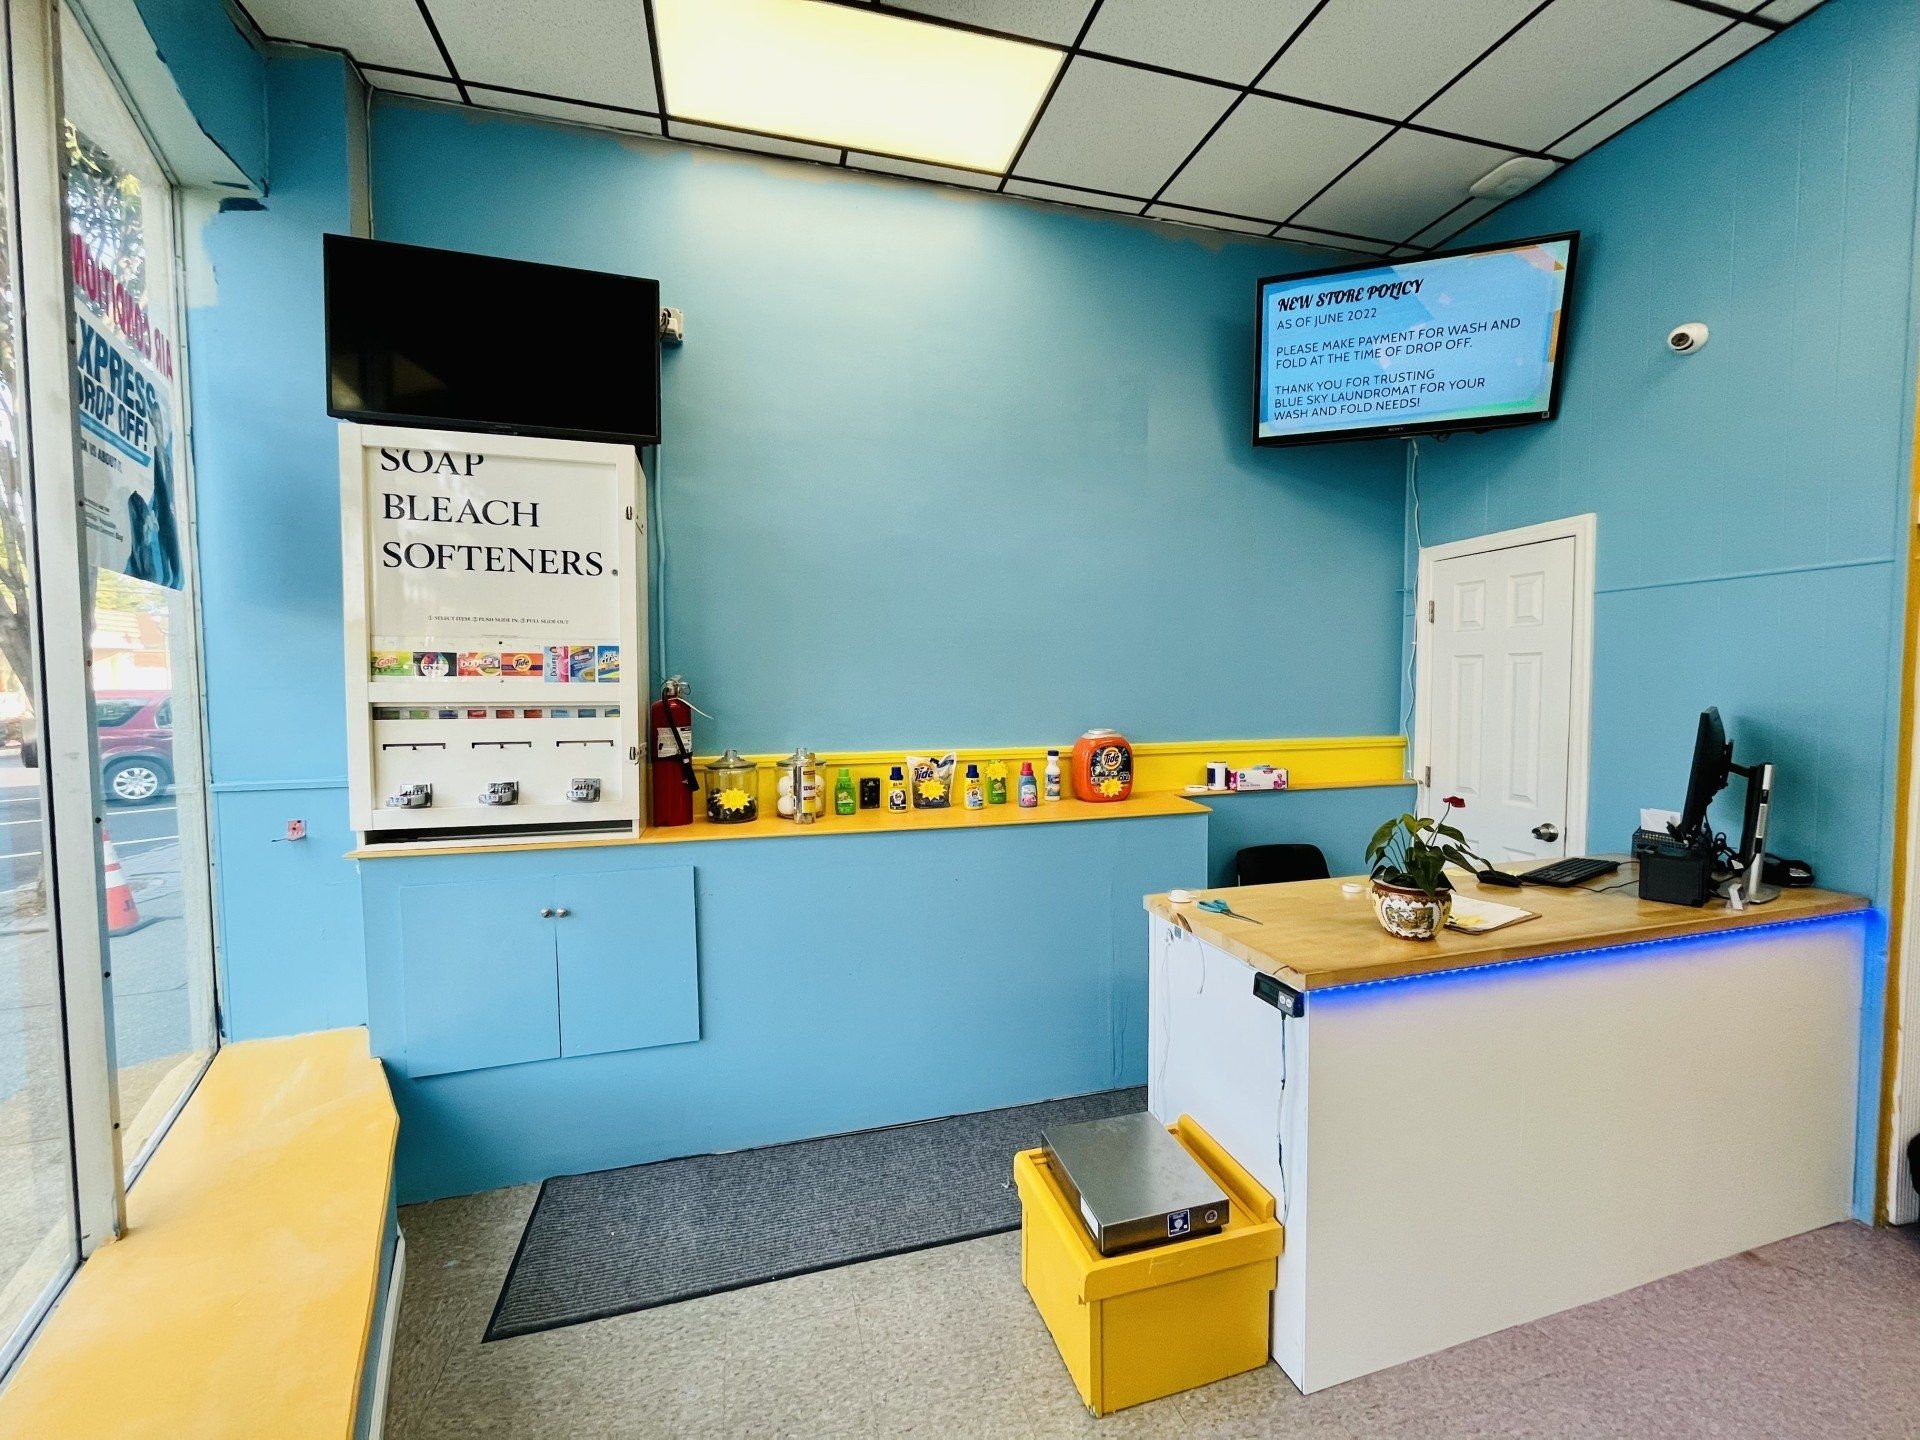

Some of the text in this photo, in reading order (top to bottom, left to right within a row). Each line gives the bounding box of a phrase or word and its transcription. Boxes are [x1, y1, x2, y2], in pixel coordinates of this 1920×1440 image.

[1278, 279, 1424, 312] NEW STORE POLICY
[1277, 308, 1377, 331] AS OF JUNE 2022
[1276, 318, 1521, 356] PLEASE MAKE PAYMENT FOR WASH AND
[1276, 337, 1473, 369] FOLD AT THE TIME OF DROP OFF.
[1274, 377, 1486, 408] BLUE SKY LAUNDROMAT FOR YOUR
[1275, 369, 1435, 395] THANK YOU FOR TRUSTING
[1274, 398, 1420, 421] WASH AND FOLD NEEDS!
[118, 403, 148, 452] OFF!
[380, 448, 484, 477] SOAP
[382, 493, 539, 528] BLEACH
[382, 541, 603, 577] SOFTENERS
[514, 657, 530, 668] Tide
[1104, 751, 1120, 766] Tide
[913, 766, 934, 782] Tide
